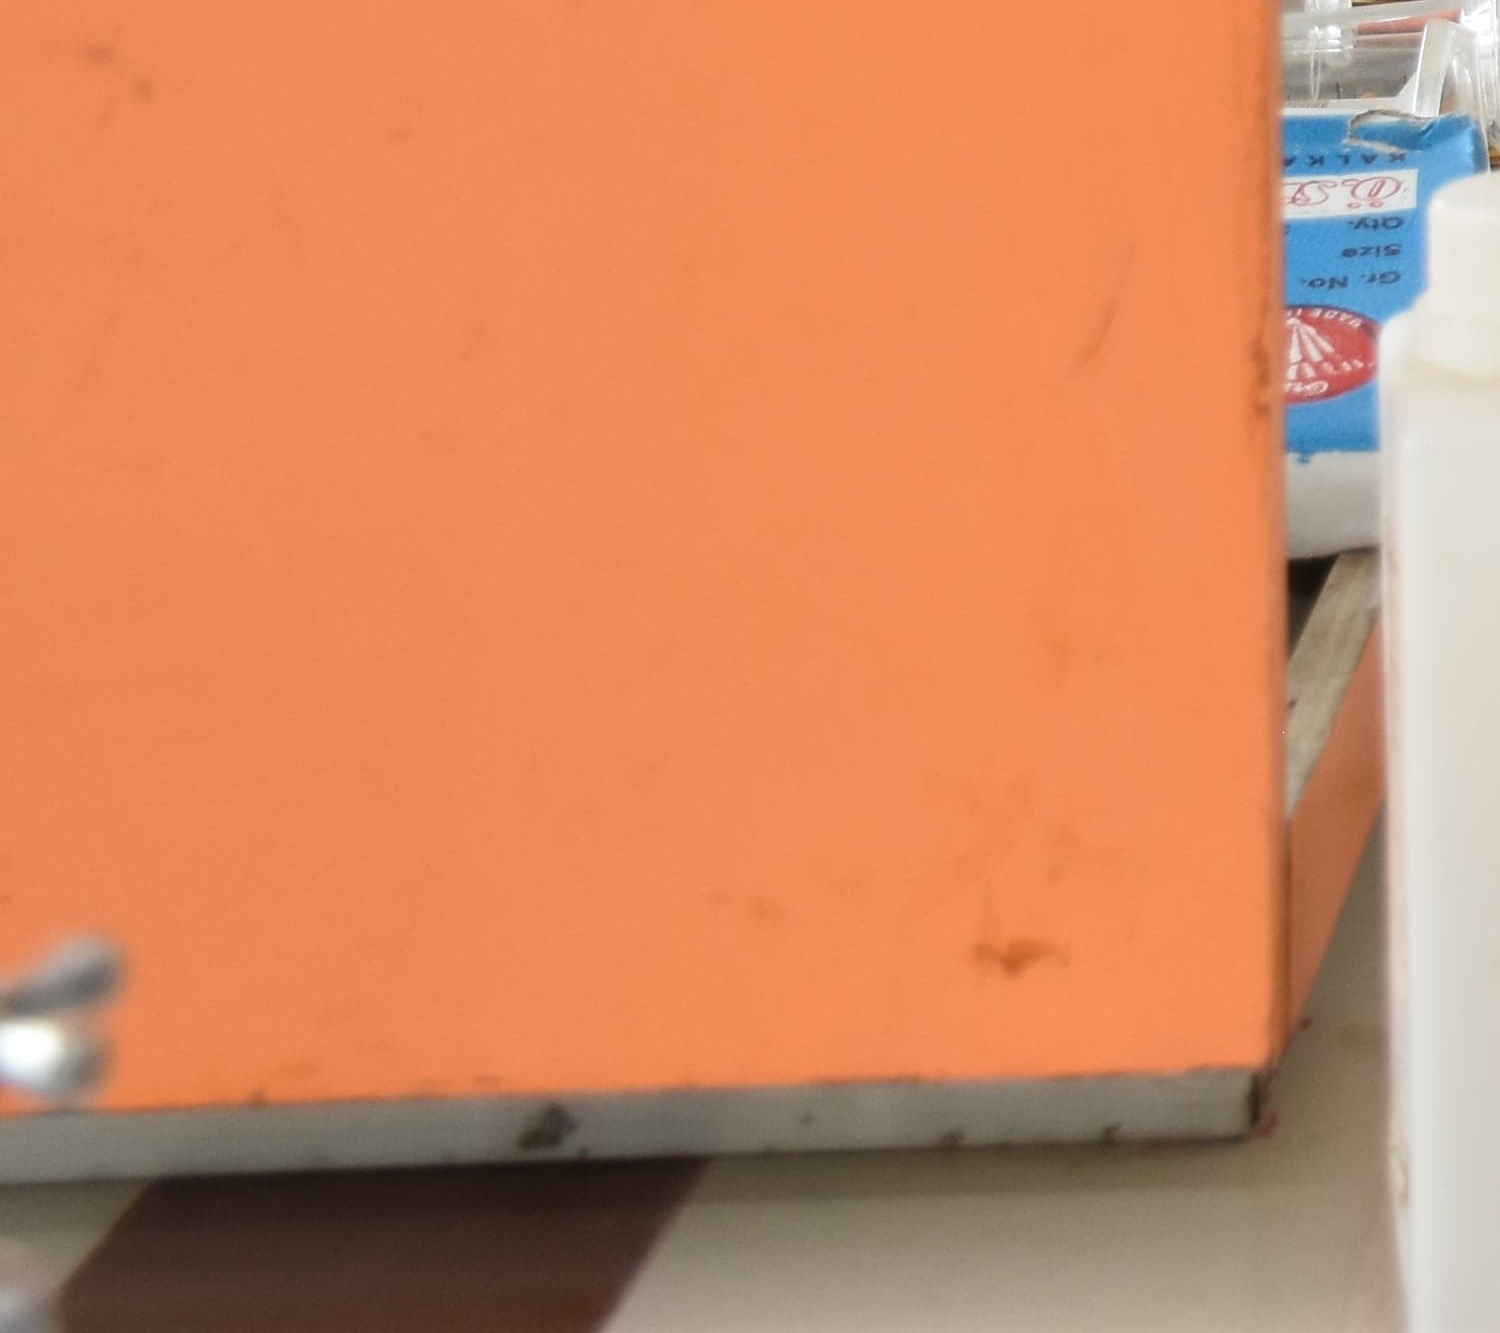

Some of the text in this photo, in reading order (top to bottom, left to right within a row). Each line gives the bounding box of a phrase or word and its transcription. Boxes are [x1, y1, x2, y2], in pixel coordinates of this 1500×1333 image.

[1347, 216, 1404, 230] Qty.
[1341, 243, 1402, 258] Size
[1302, 271, 1401, 289] Gr. No.
